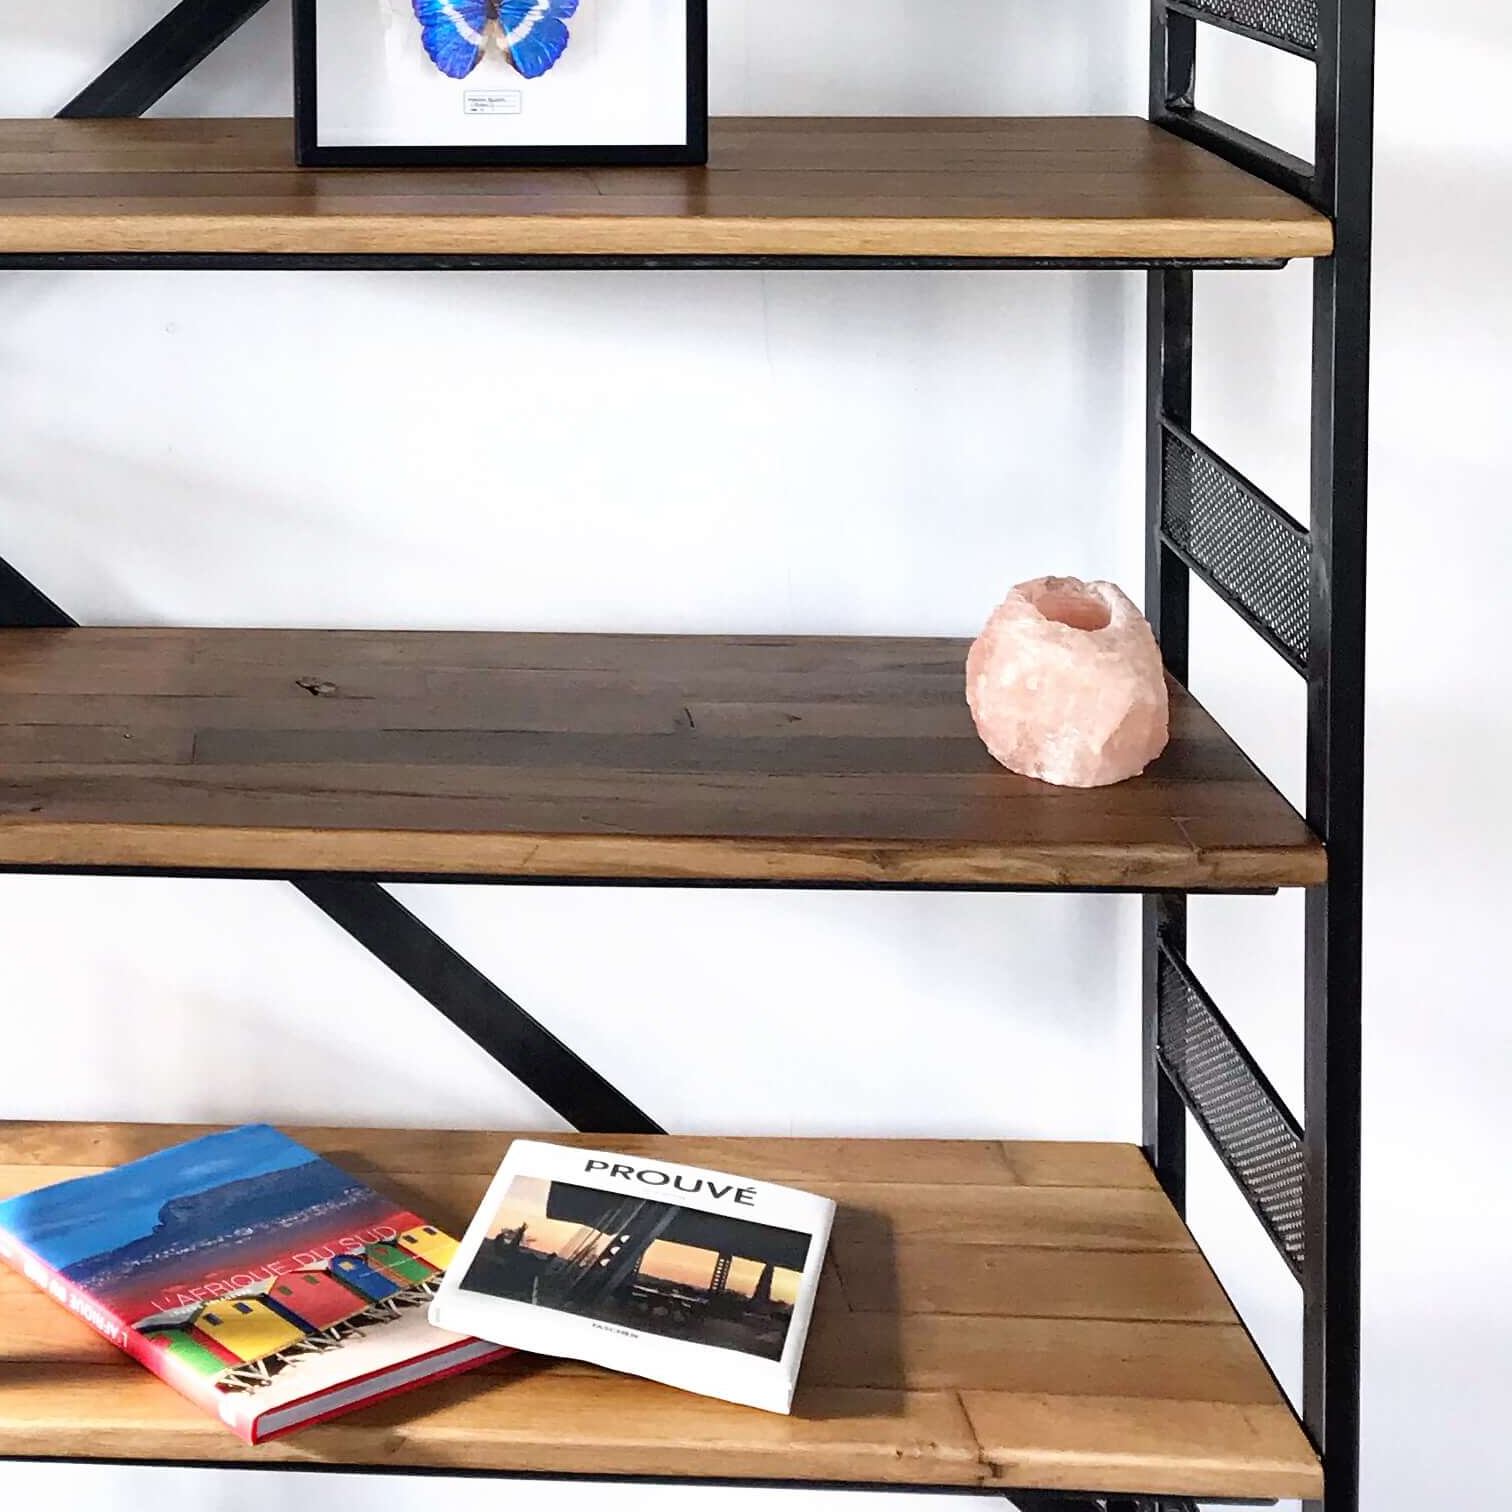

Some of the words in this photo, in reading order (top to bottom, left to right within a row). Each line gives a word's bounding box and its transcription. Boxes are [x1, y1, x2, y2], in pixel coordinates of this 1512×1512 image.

[584, 1159, 758, 1207] PROUVÉ
[151, 1260, 289, 1314] L'AFRIQUE
[292, 1245, 337, 1272] DU
[339, 1225, 398, 1254] SUD
